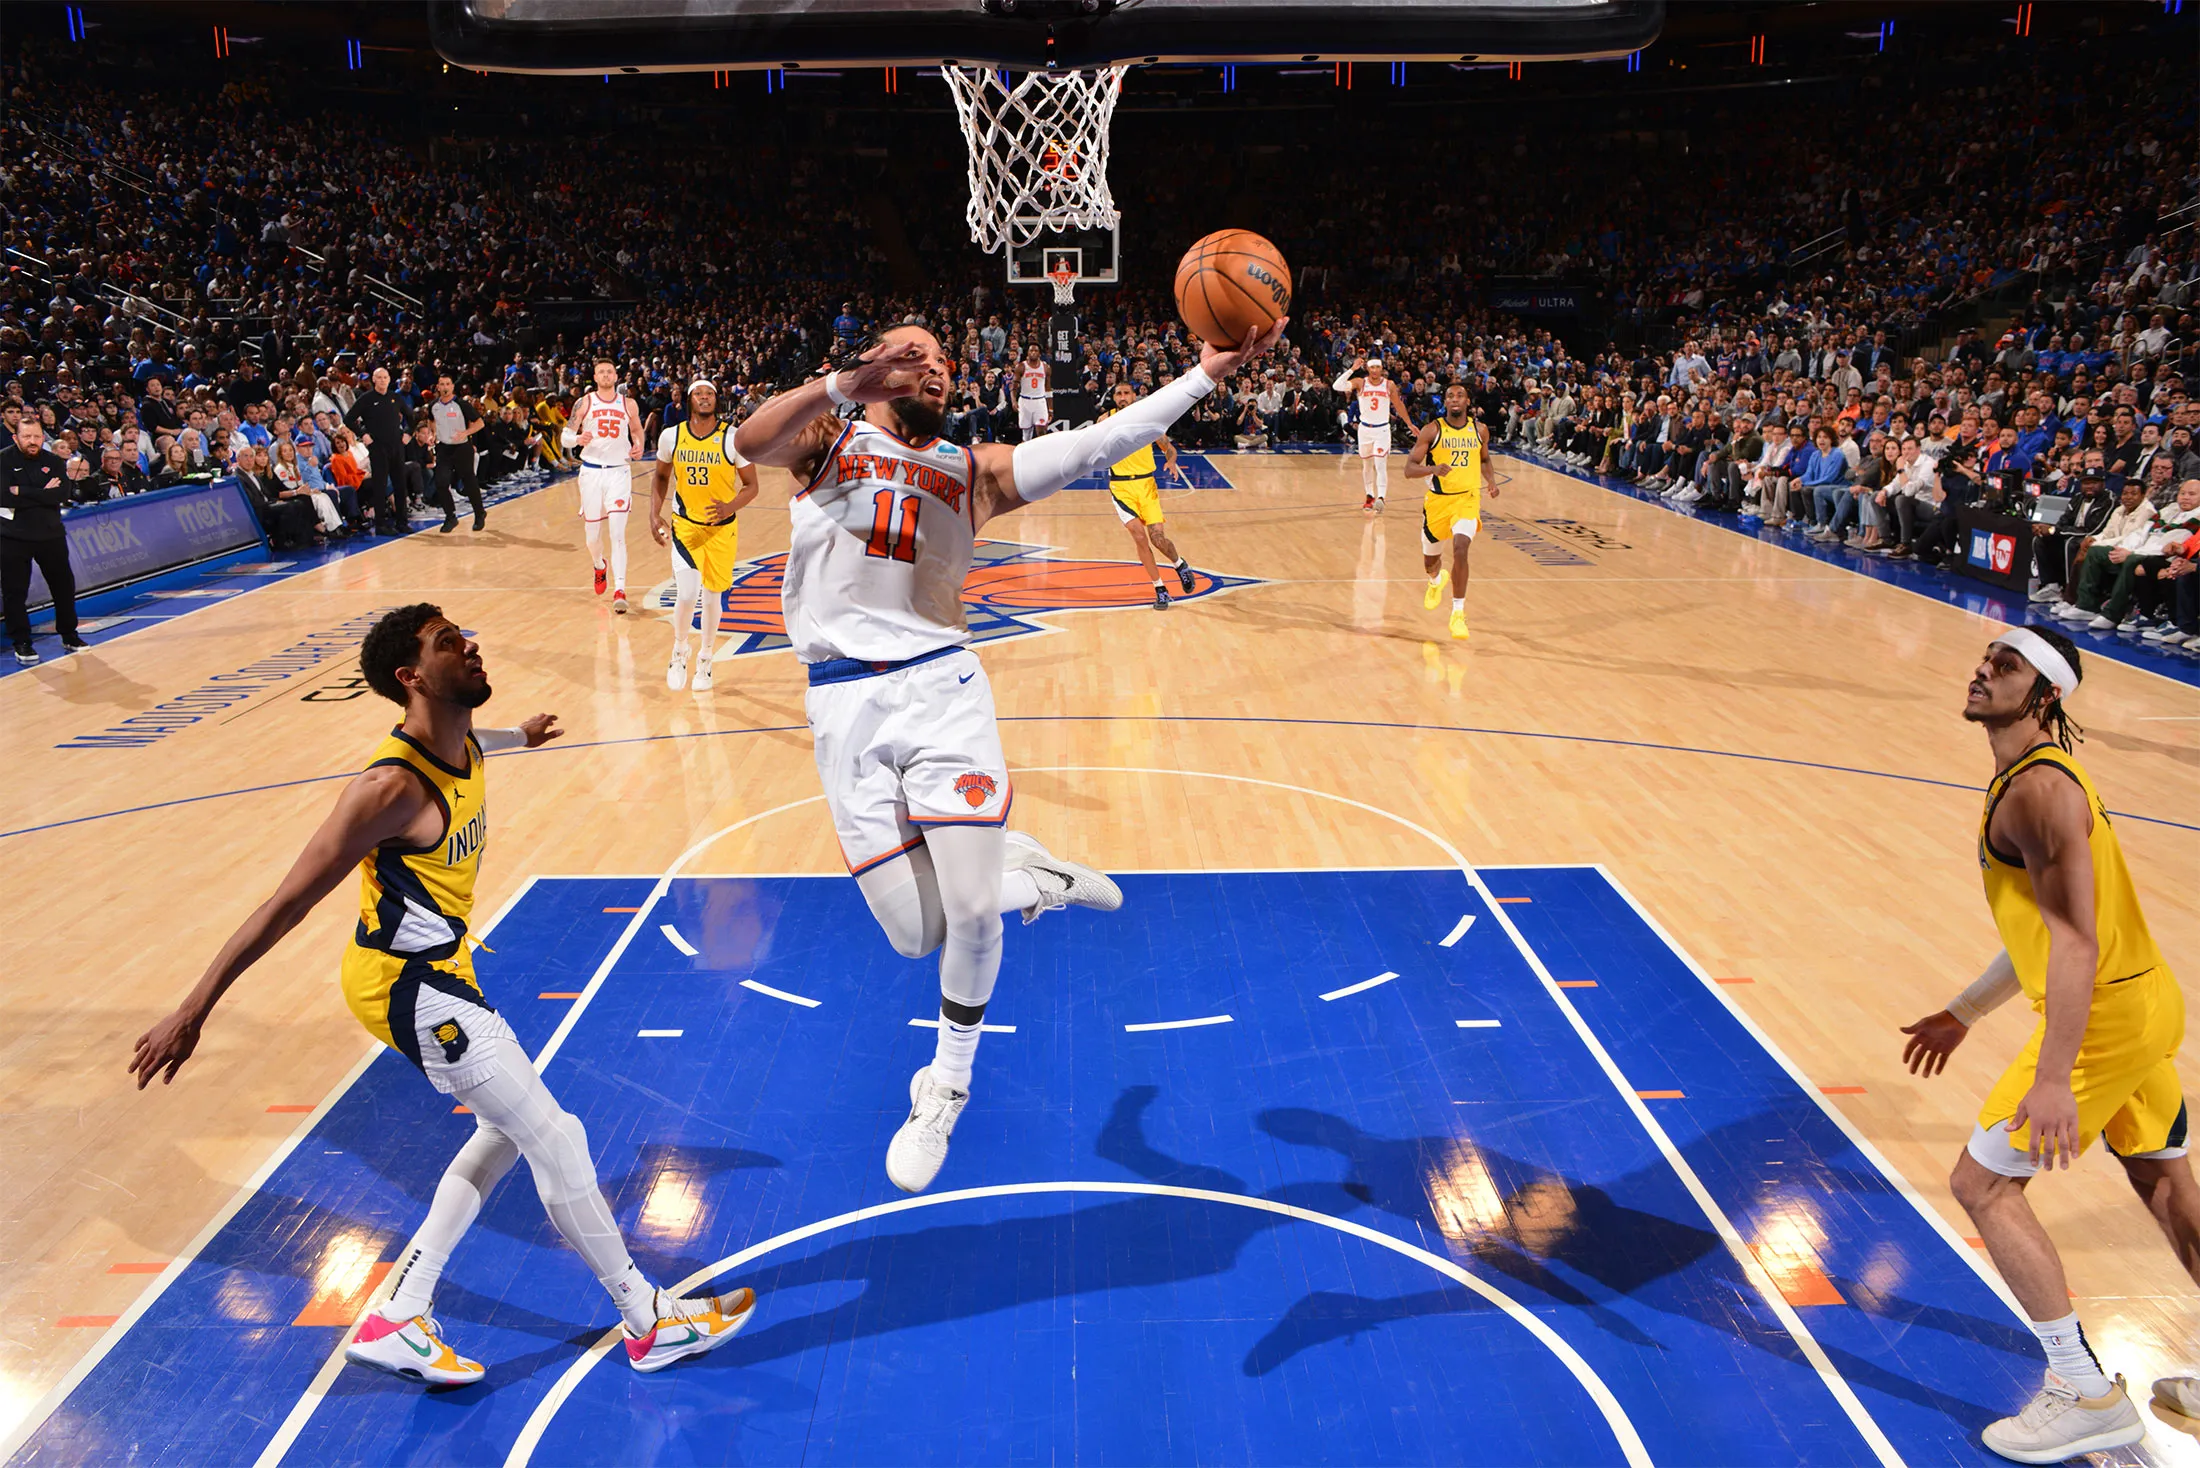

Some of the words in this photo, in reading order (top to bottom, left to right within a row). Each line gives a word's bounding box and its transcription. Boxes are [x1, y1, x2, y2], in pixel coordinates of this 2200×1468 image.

[1538, 297, 1574, 308] ULTRA
[1057, 330, 1069, 340] GET
[1057, 340, 1069, 350] THE
[1031, 377, 1038, 389] 8
[1369, 397, 1379, 411] 3
[592, 409, 608, 418] NEW
[610, 409, 625, 420] YORK
[598, 419, 620, 438] 55
[1441, 438, 1478, 449] INDIANA
[677, 450, 721, 465] INDIANA
[1451, 450, 1469, 467] 23
[686, 466, 709, 485] 33
[836, 454, 899, 484] NEW
[902, 461, 966, 514] YORK
[175, 497, 232, 533] max
[865, 487, 921, 564] 11
[70, 518, 142, 560] max
[53, 685, 270, 749] MADISON
[209, 641, 361, 681] SQUARE
[954, 773, 996, 795] KNICKS
